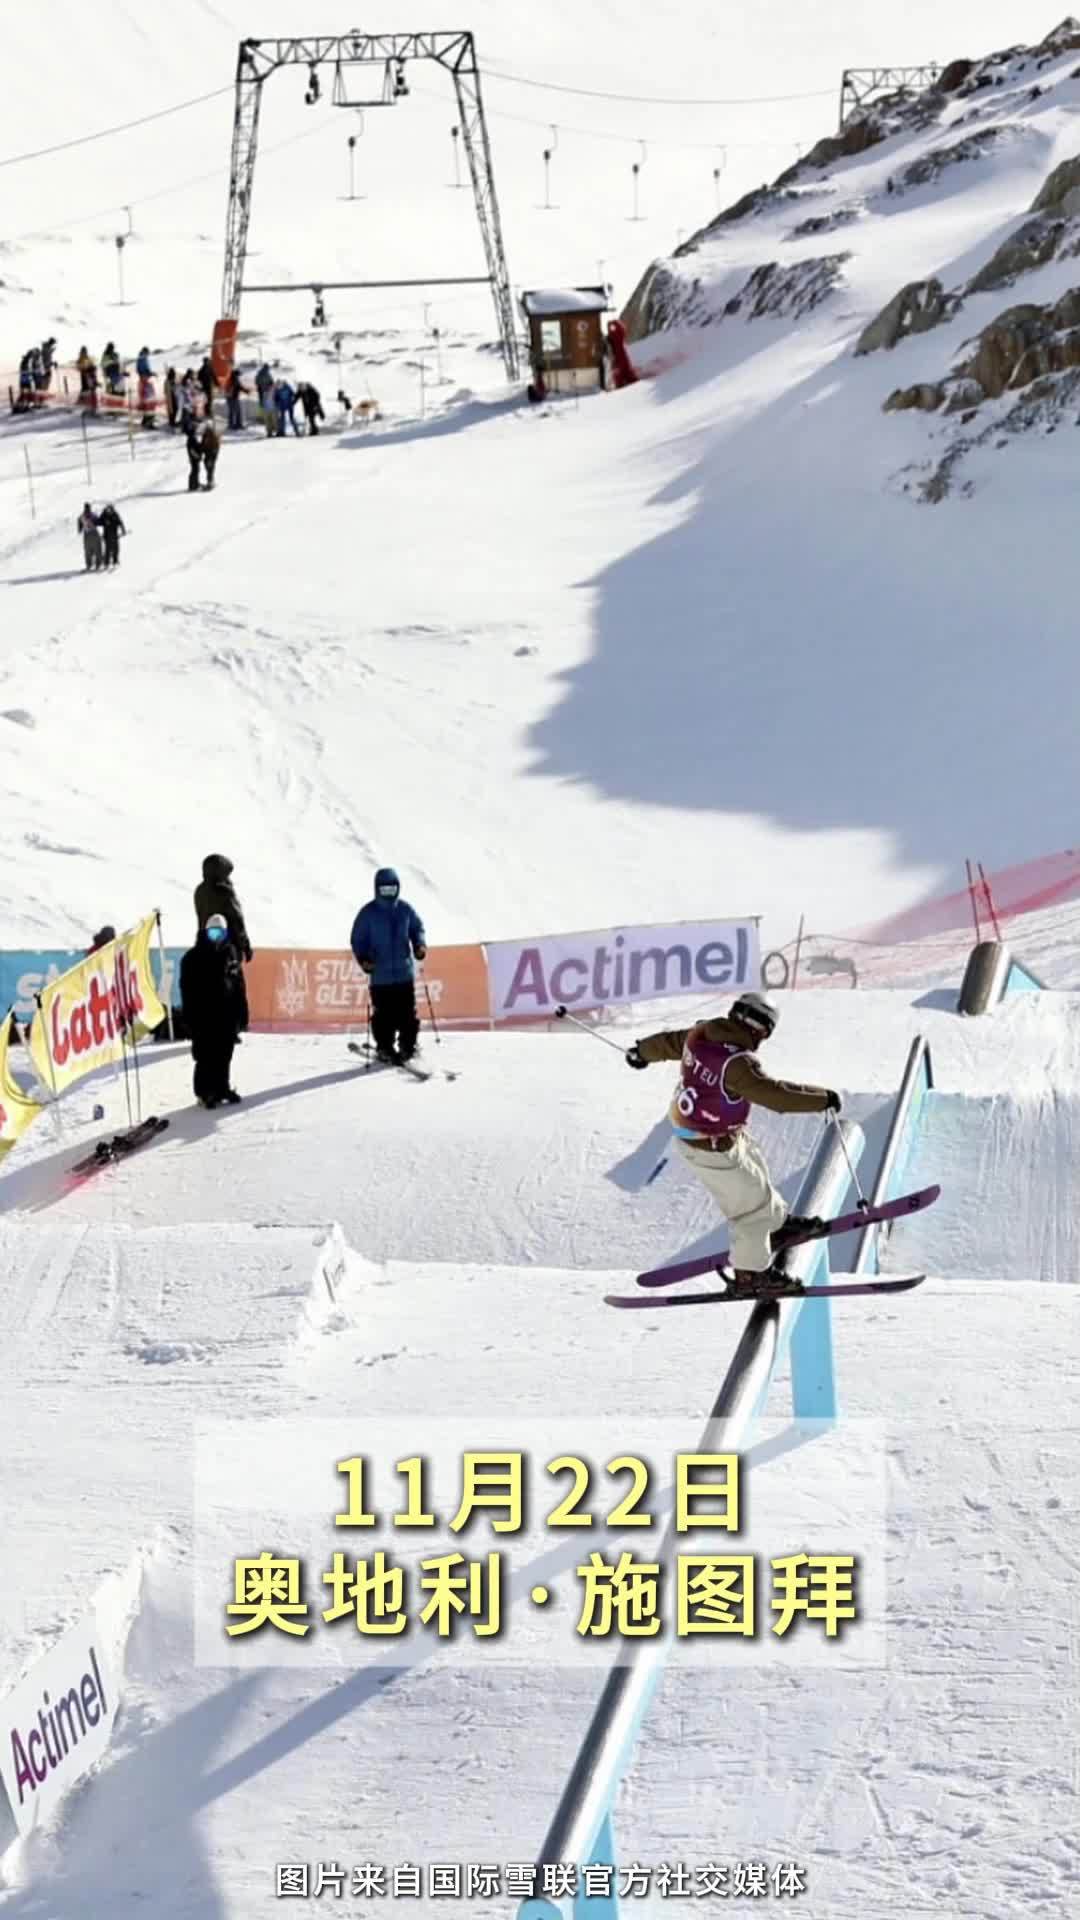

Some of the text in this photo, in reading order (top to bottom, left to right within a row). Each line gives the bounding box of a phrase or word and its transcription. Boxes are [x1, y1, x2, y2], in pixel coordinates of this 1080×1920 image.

[314, 980, 442, 1006] GLETER
[503, 927, 748, 1009] Actimel
[10, 1646, 108, 1805] Actimel
